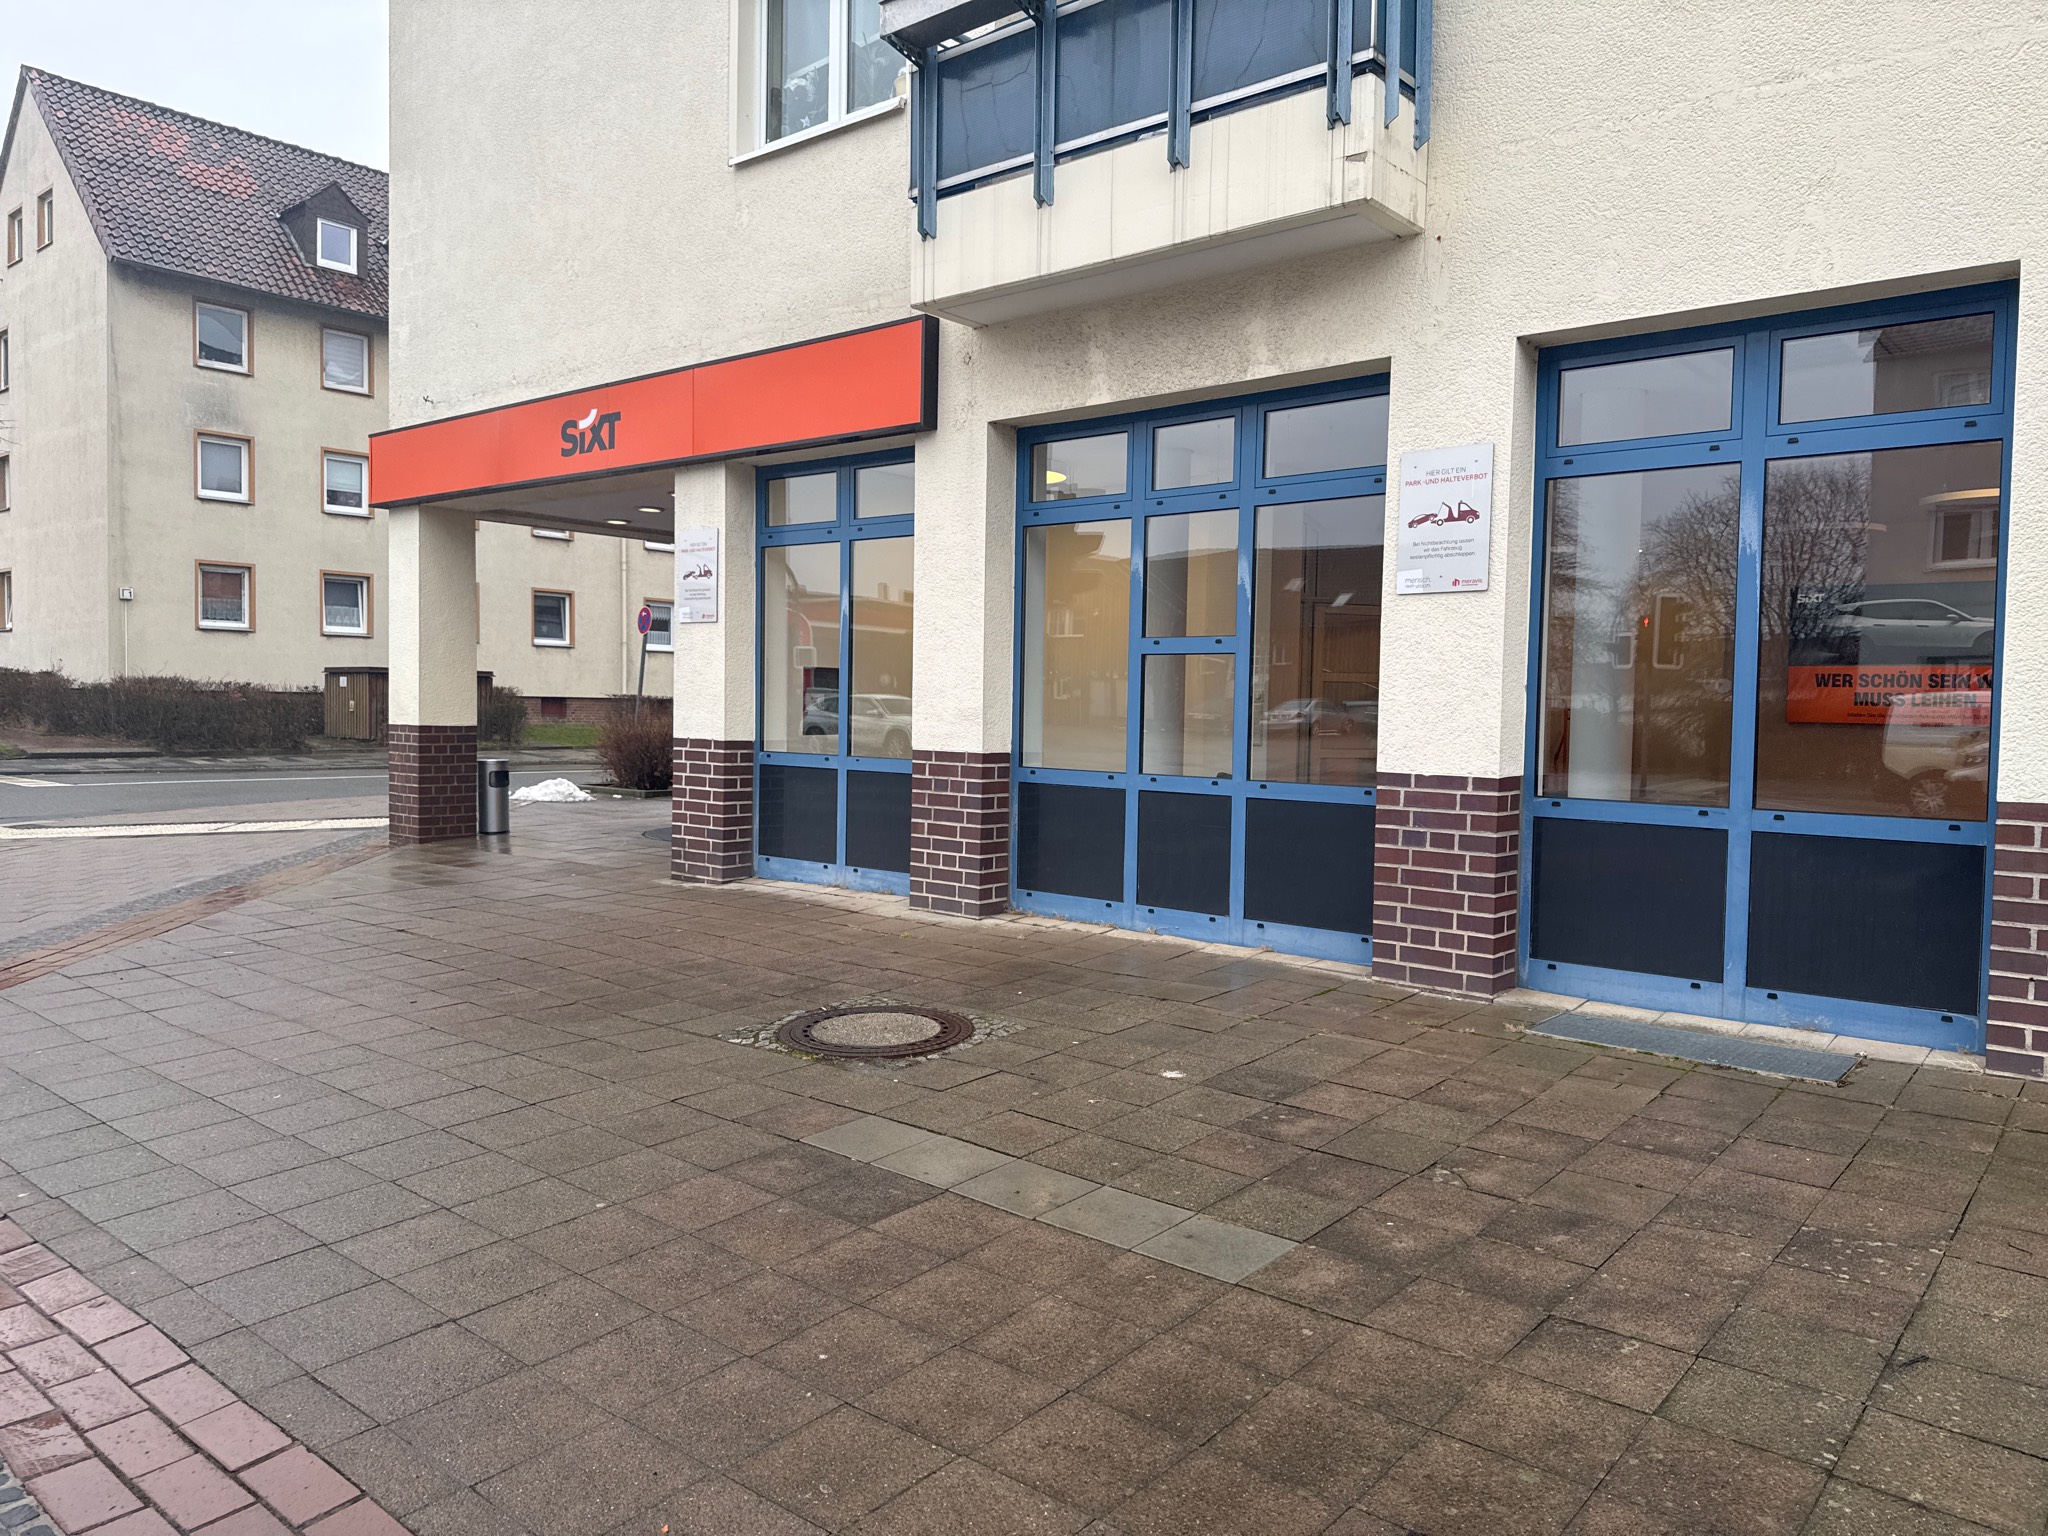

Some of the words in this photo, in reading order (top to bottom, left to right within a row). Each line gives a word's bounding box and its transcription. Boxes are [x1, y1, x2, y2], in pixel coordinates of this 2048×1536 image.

[1441, 472, 1488, 483] HALTEVERBOT
[1815, 673, 1853, 688] WER
[1858, 671, 1922, 688] SCHÖN
[1927, 673, 1971, 689] SEIN
[1854, 692, 1905, 707] MUSS
